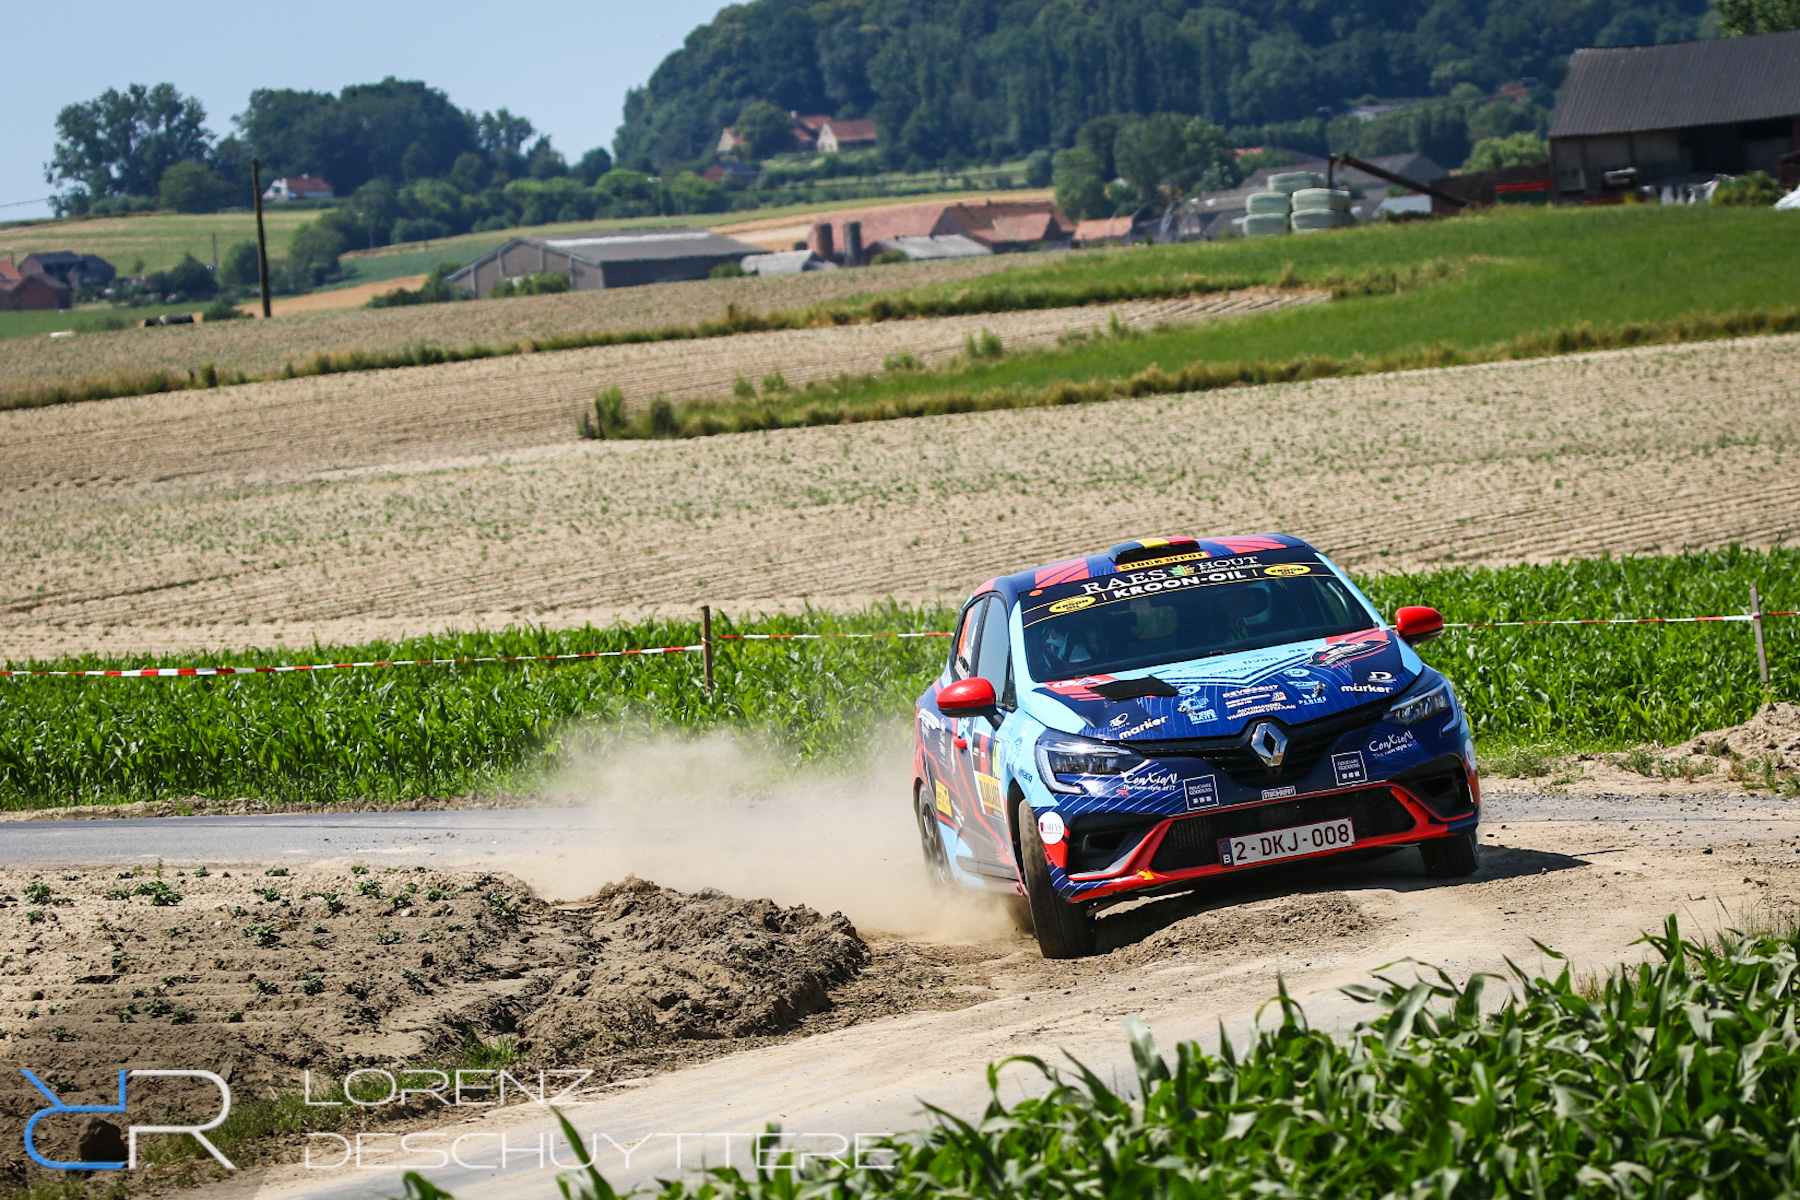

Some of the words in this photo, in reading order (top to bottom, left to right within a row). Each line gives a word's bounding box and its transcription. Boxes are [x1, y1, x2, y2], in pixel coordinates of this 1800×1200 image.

[1081, 569, 1169, 596] RAES
[1197, 556, 1259, 571] HOUT
[1112, 571, 1247, 598] KROON-OIL
[1118, 715, 1169, 740] marker
[1234, 823, 1350, 861] 2-DKJ-008
[1223, 855, 1232, 864] B
